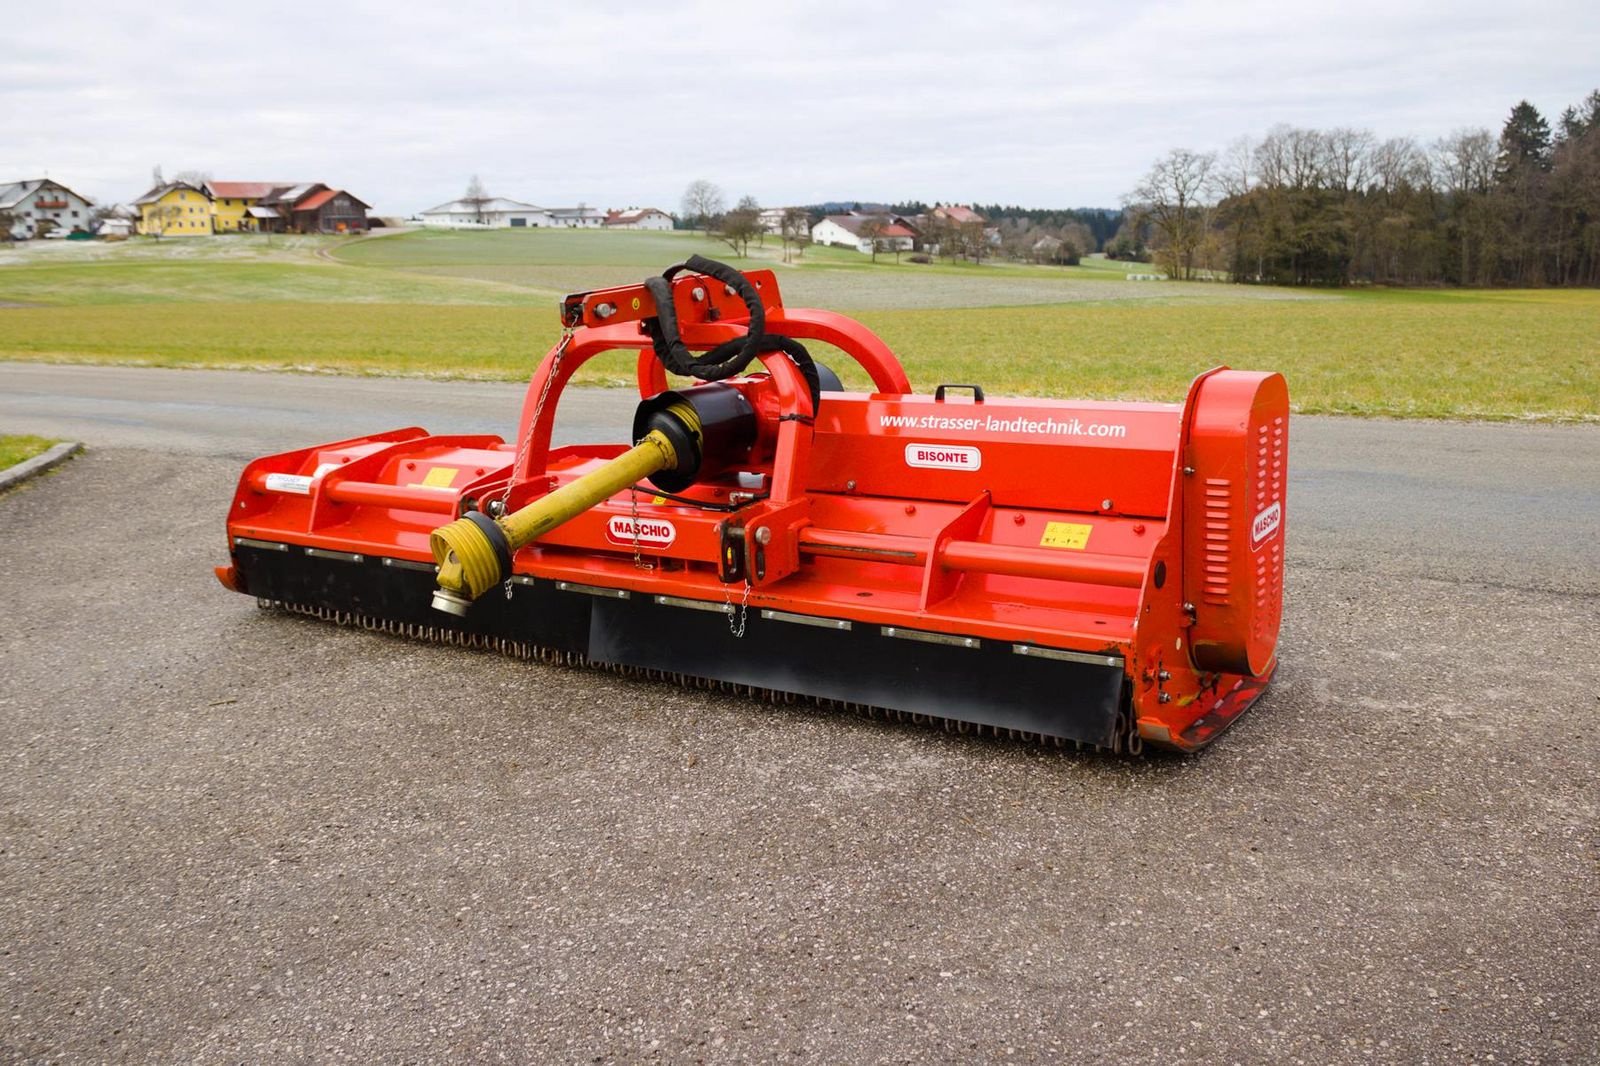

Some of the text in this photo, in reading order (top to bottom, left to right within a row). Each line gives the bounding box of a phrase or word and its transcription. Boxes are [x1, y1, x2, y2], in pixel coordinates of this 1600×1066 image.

[879, 414, 1126, 437] www.strasser-landtechnik.com
[917, 450, 968, 464] BISONTE
[613, 521, 671, 538] MASCHIO
